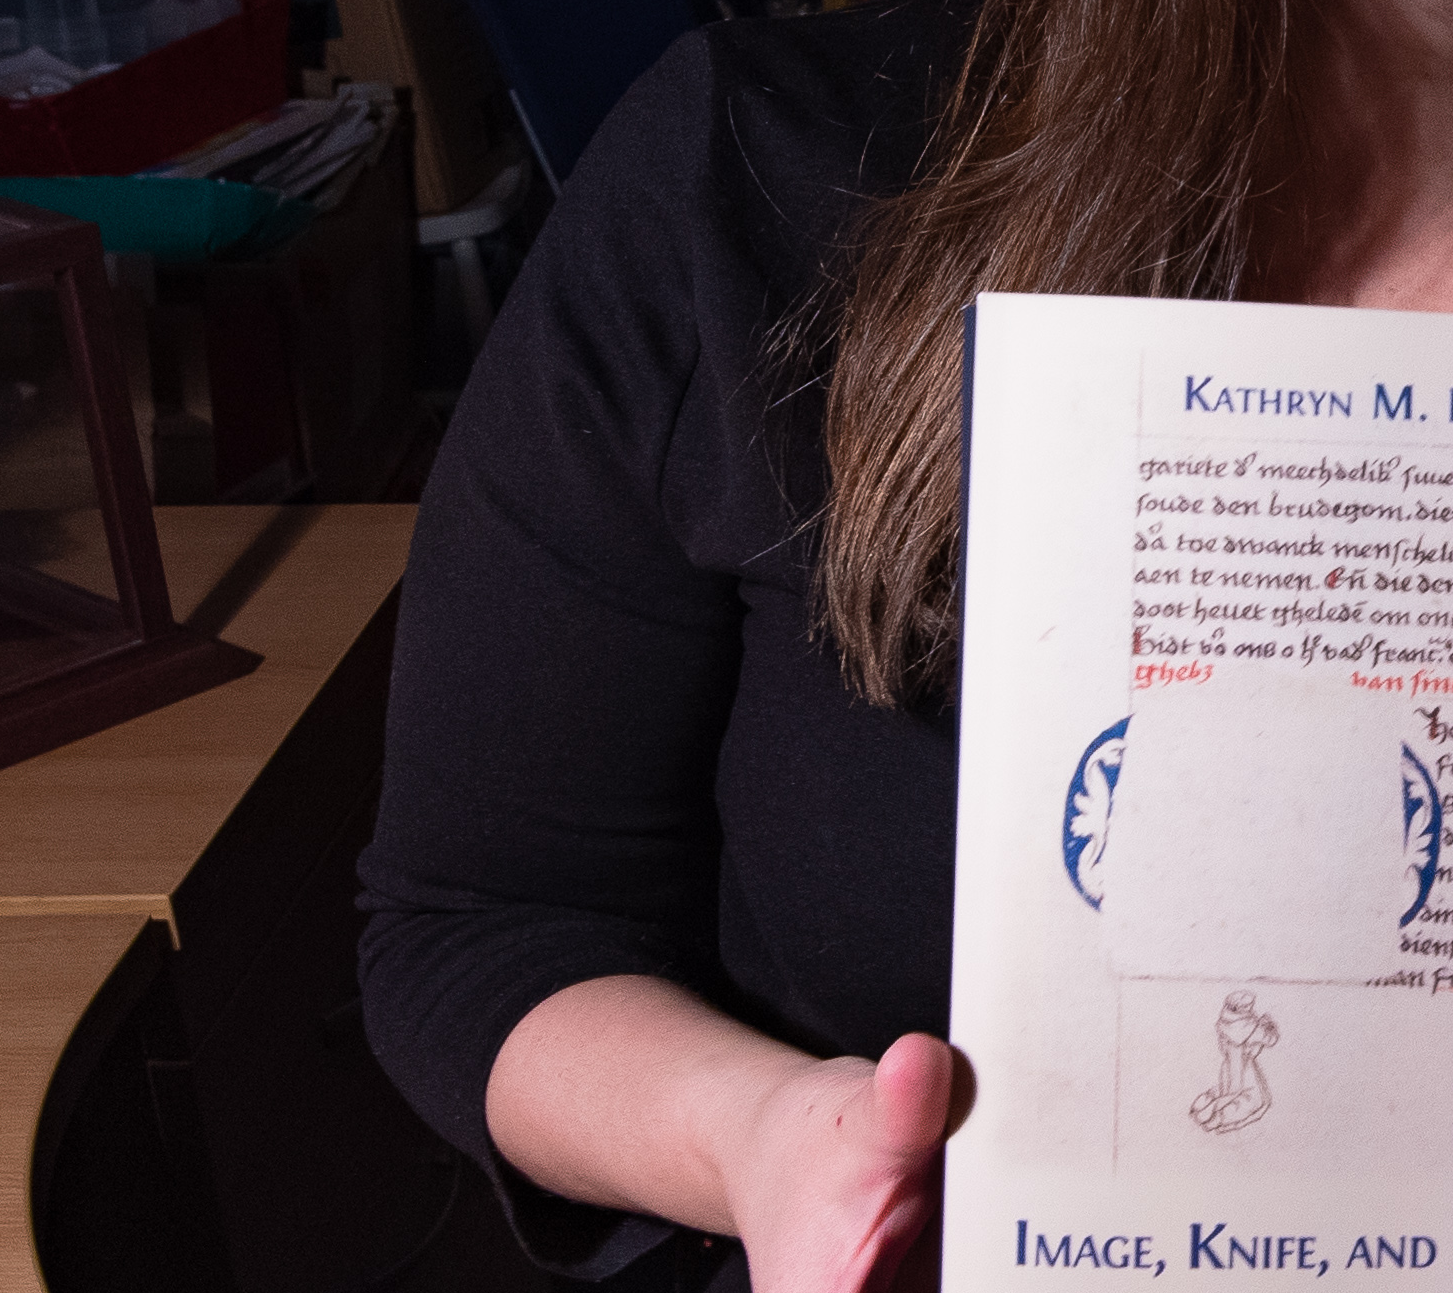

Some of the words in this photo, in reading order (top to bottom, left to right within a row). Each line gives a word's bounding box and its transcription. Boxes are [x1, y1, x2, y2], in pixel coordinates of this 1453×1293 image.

[1184, 374, 1353, 418] KATHRYN
[1373, 382, 1427, 423] M.
[1014, 1218, 1169, 1278] IMAGE,
[1188, 1221, 1330, 1278] KNIFE,
[1345, 1234, 1439, 1270] AND
